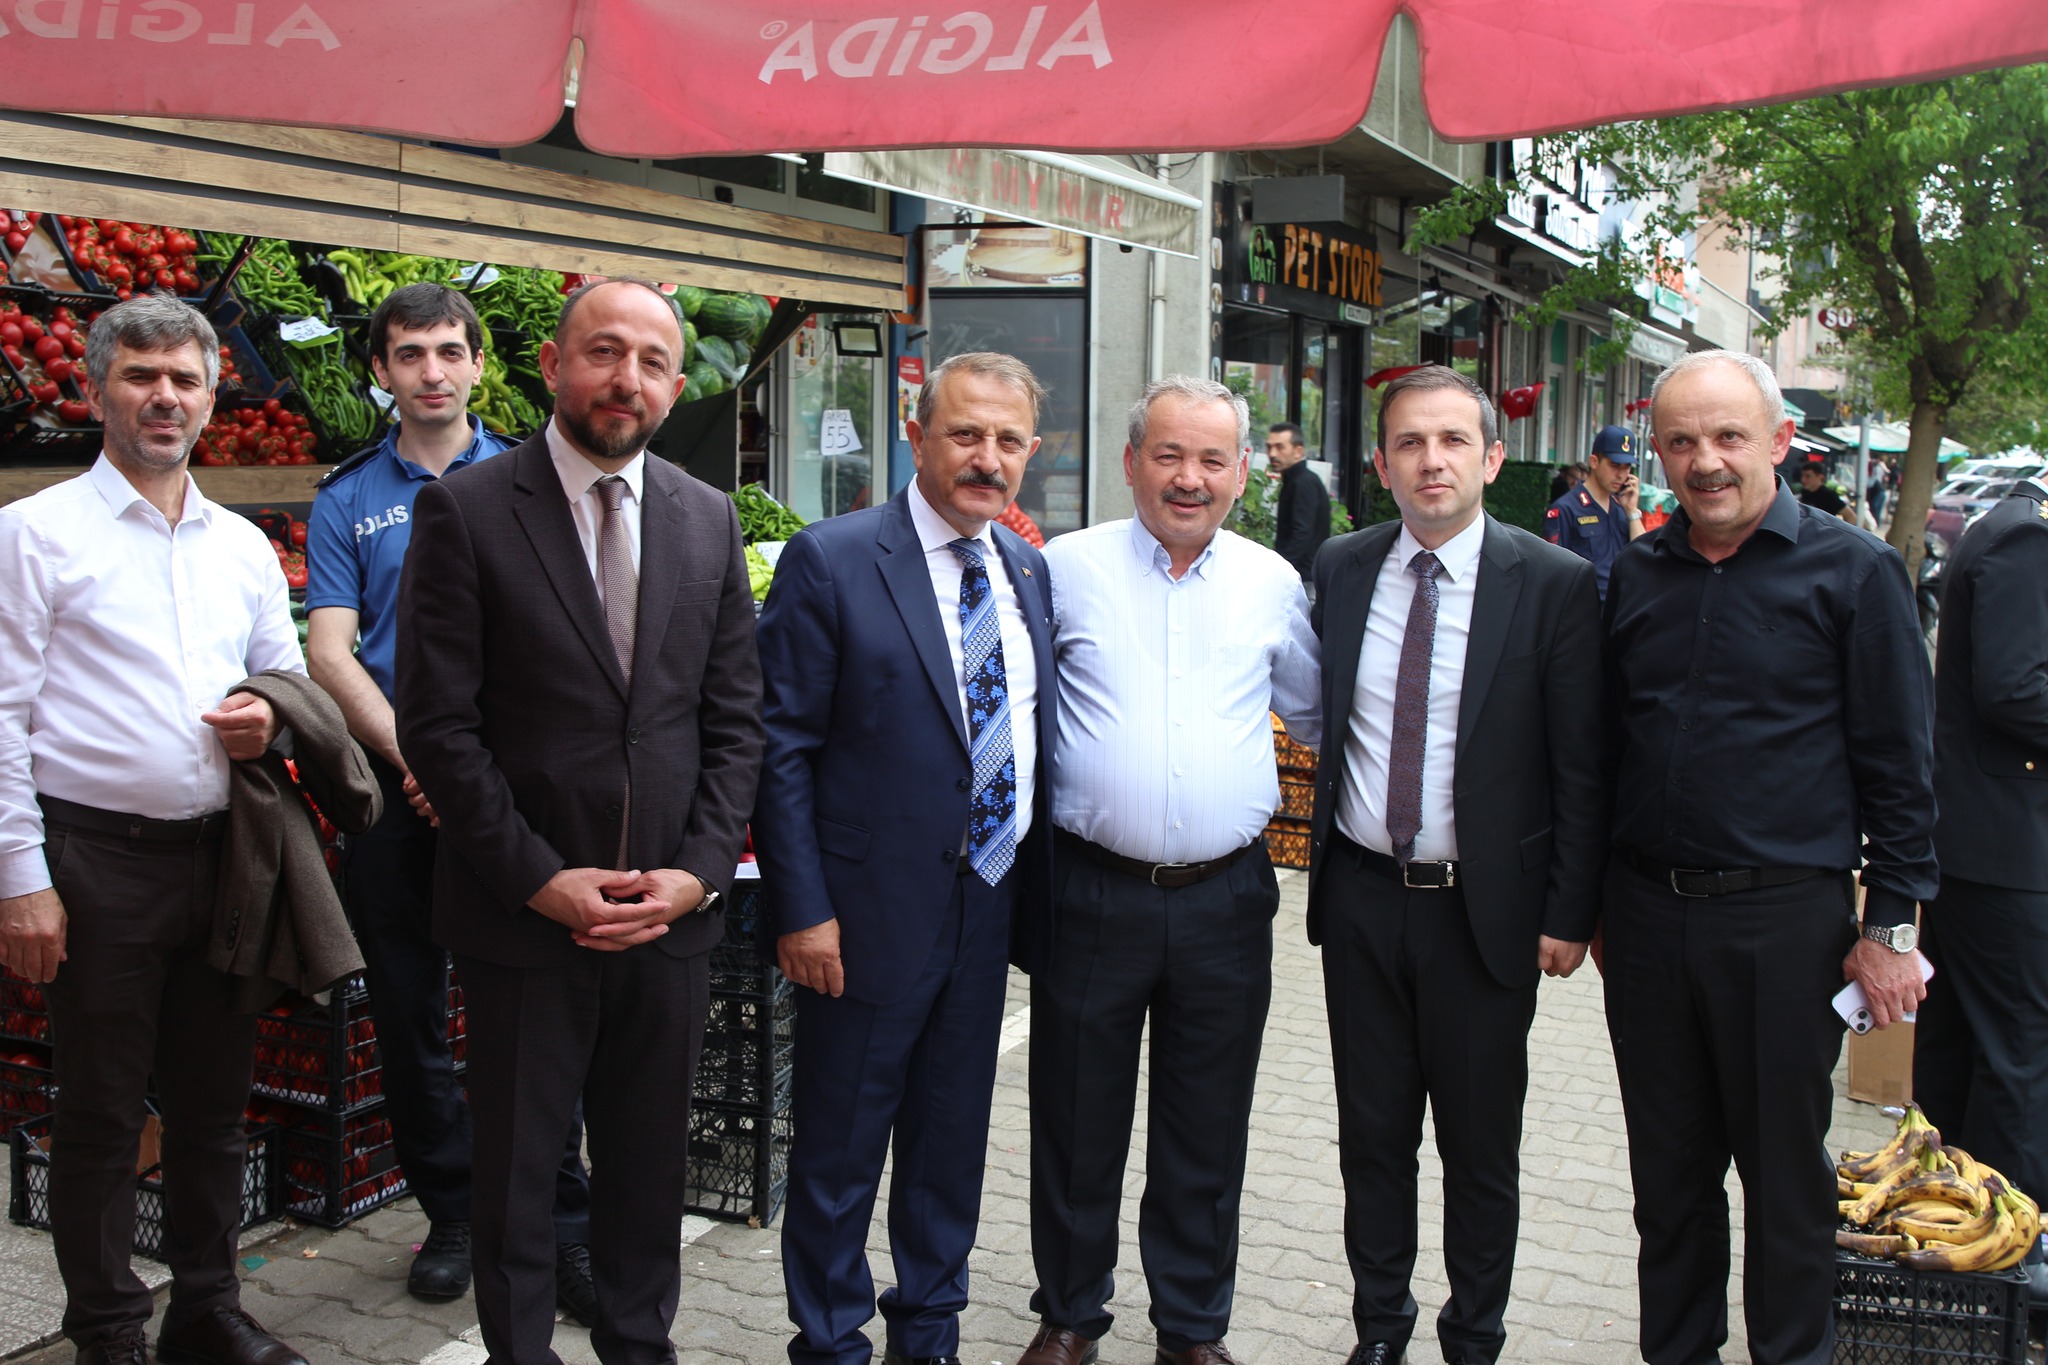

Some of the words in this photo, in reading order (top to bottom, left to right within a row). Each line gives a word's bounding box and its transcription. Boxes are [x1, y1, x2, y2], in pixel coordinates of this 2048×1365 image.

[992, 159, 1045, 211] MY
[1058, 180, 1125, 232] MAR
[1283, 223, 1323, 292] PET
[1328, 238, 1384, 307] STORE
[825, 426, 850, 449] 55
